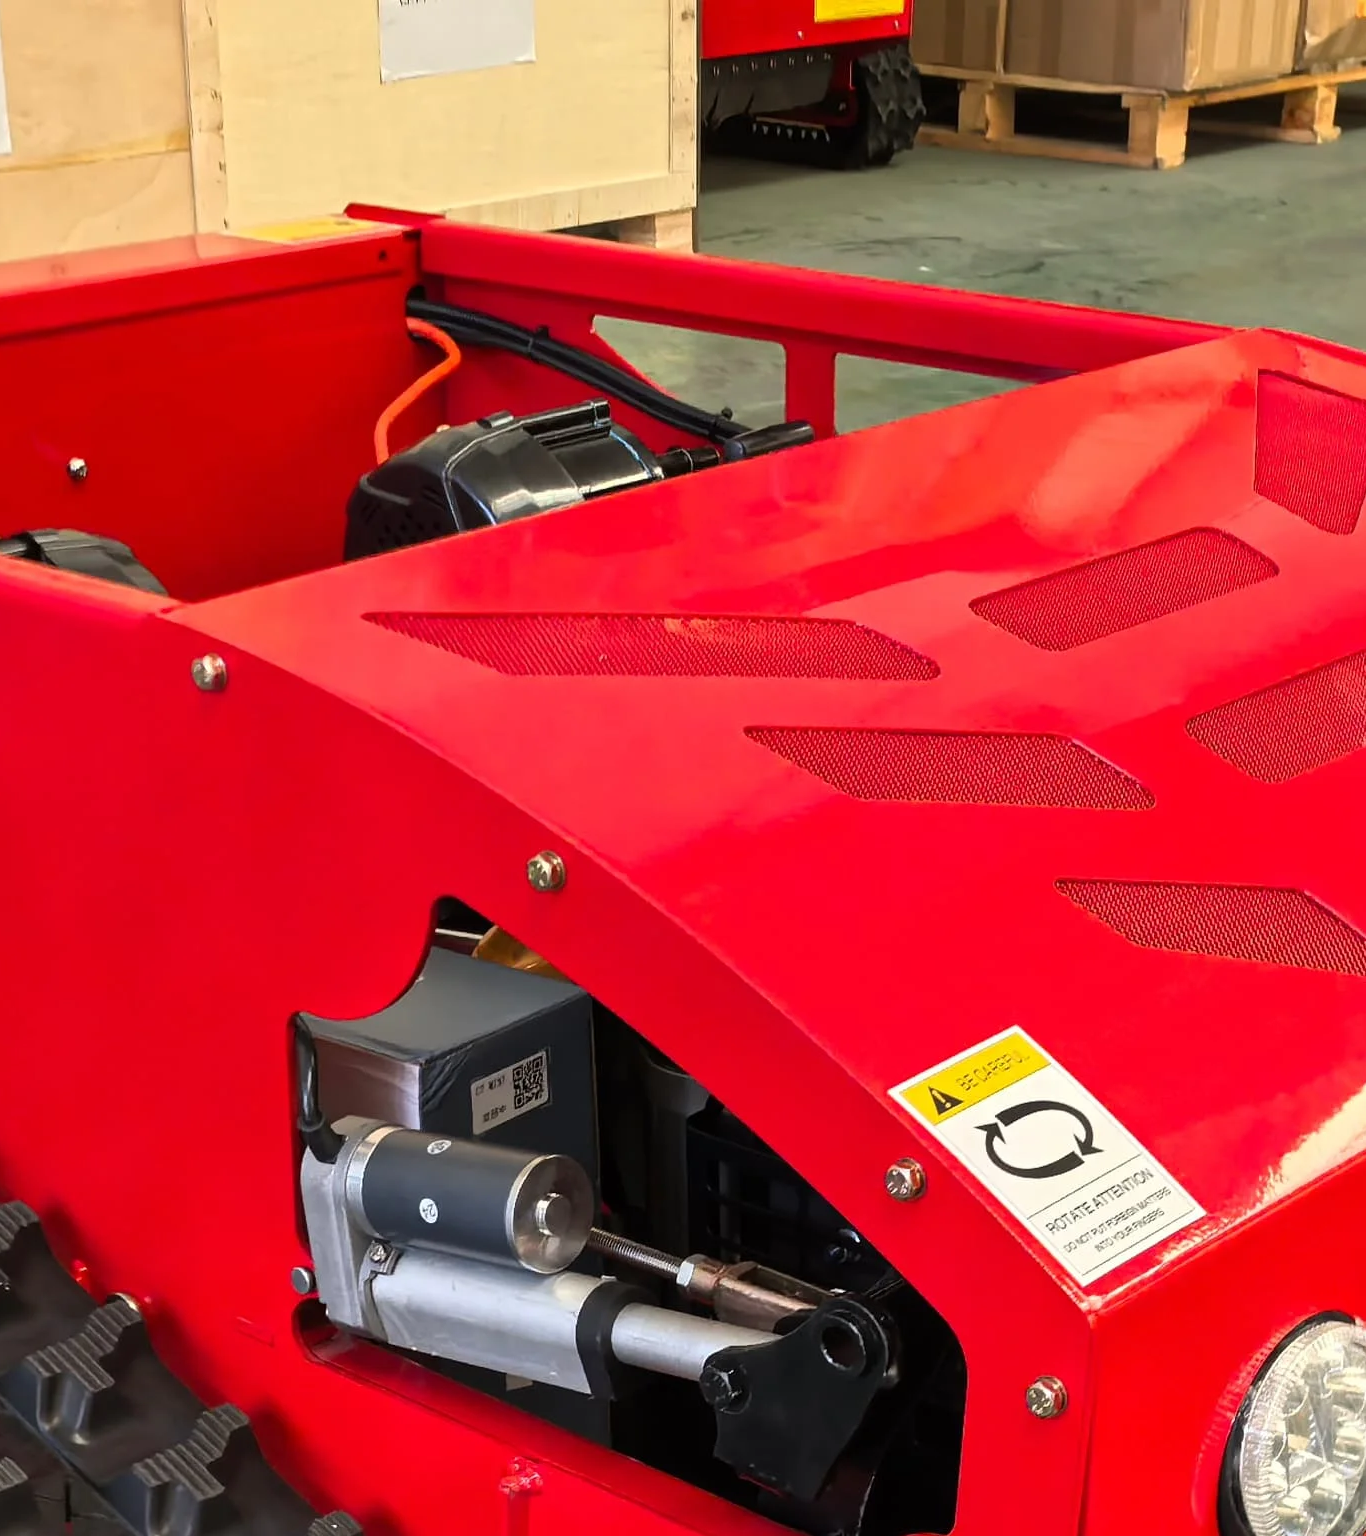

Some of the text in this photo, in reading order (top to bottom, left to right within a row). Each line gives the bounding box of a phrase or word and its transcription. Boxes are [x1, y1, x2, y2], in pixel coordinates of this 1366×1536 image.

[955, 1050, 1030, 1091] BE CAREFUL
[1044, 1168, 1154, 1234] ROTATE ATTENTION
[1063, 1241, 1078, 1253] DO
[1074, 1231, 1093, 1245] NOT
[1090, 1223, 1108, 1236] PUT
[1135, 1186, 1172, 1210] MATTERS
[1131, 1207, 1165, 1229] FINGERS
